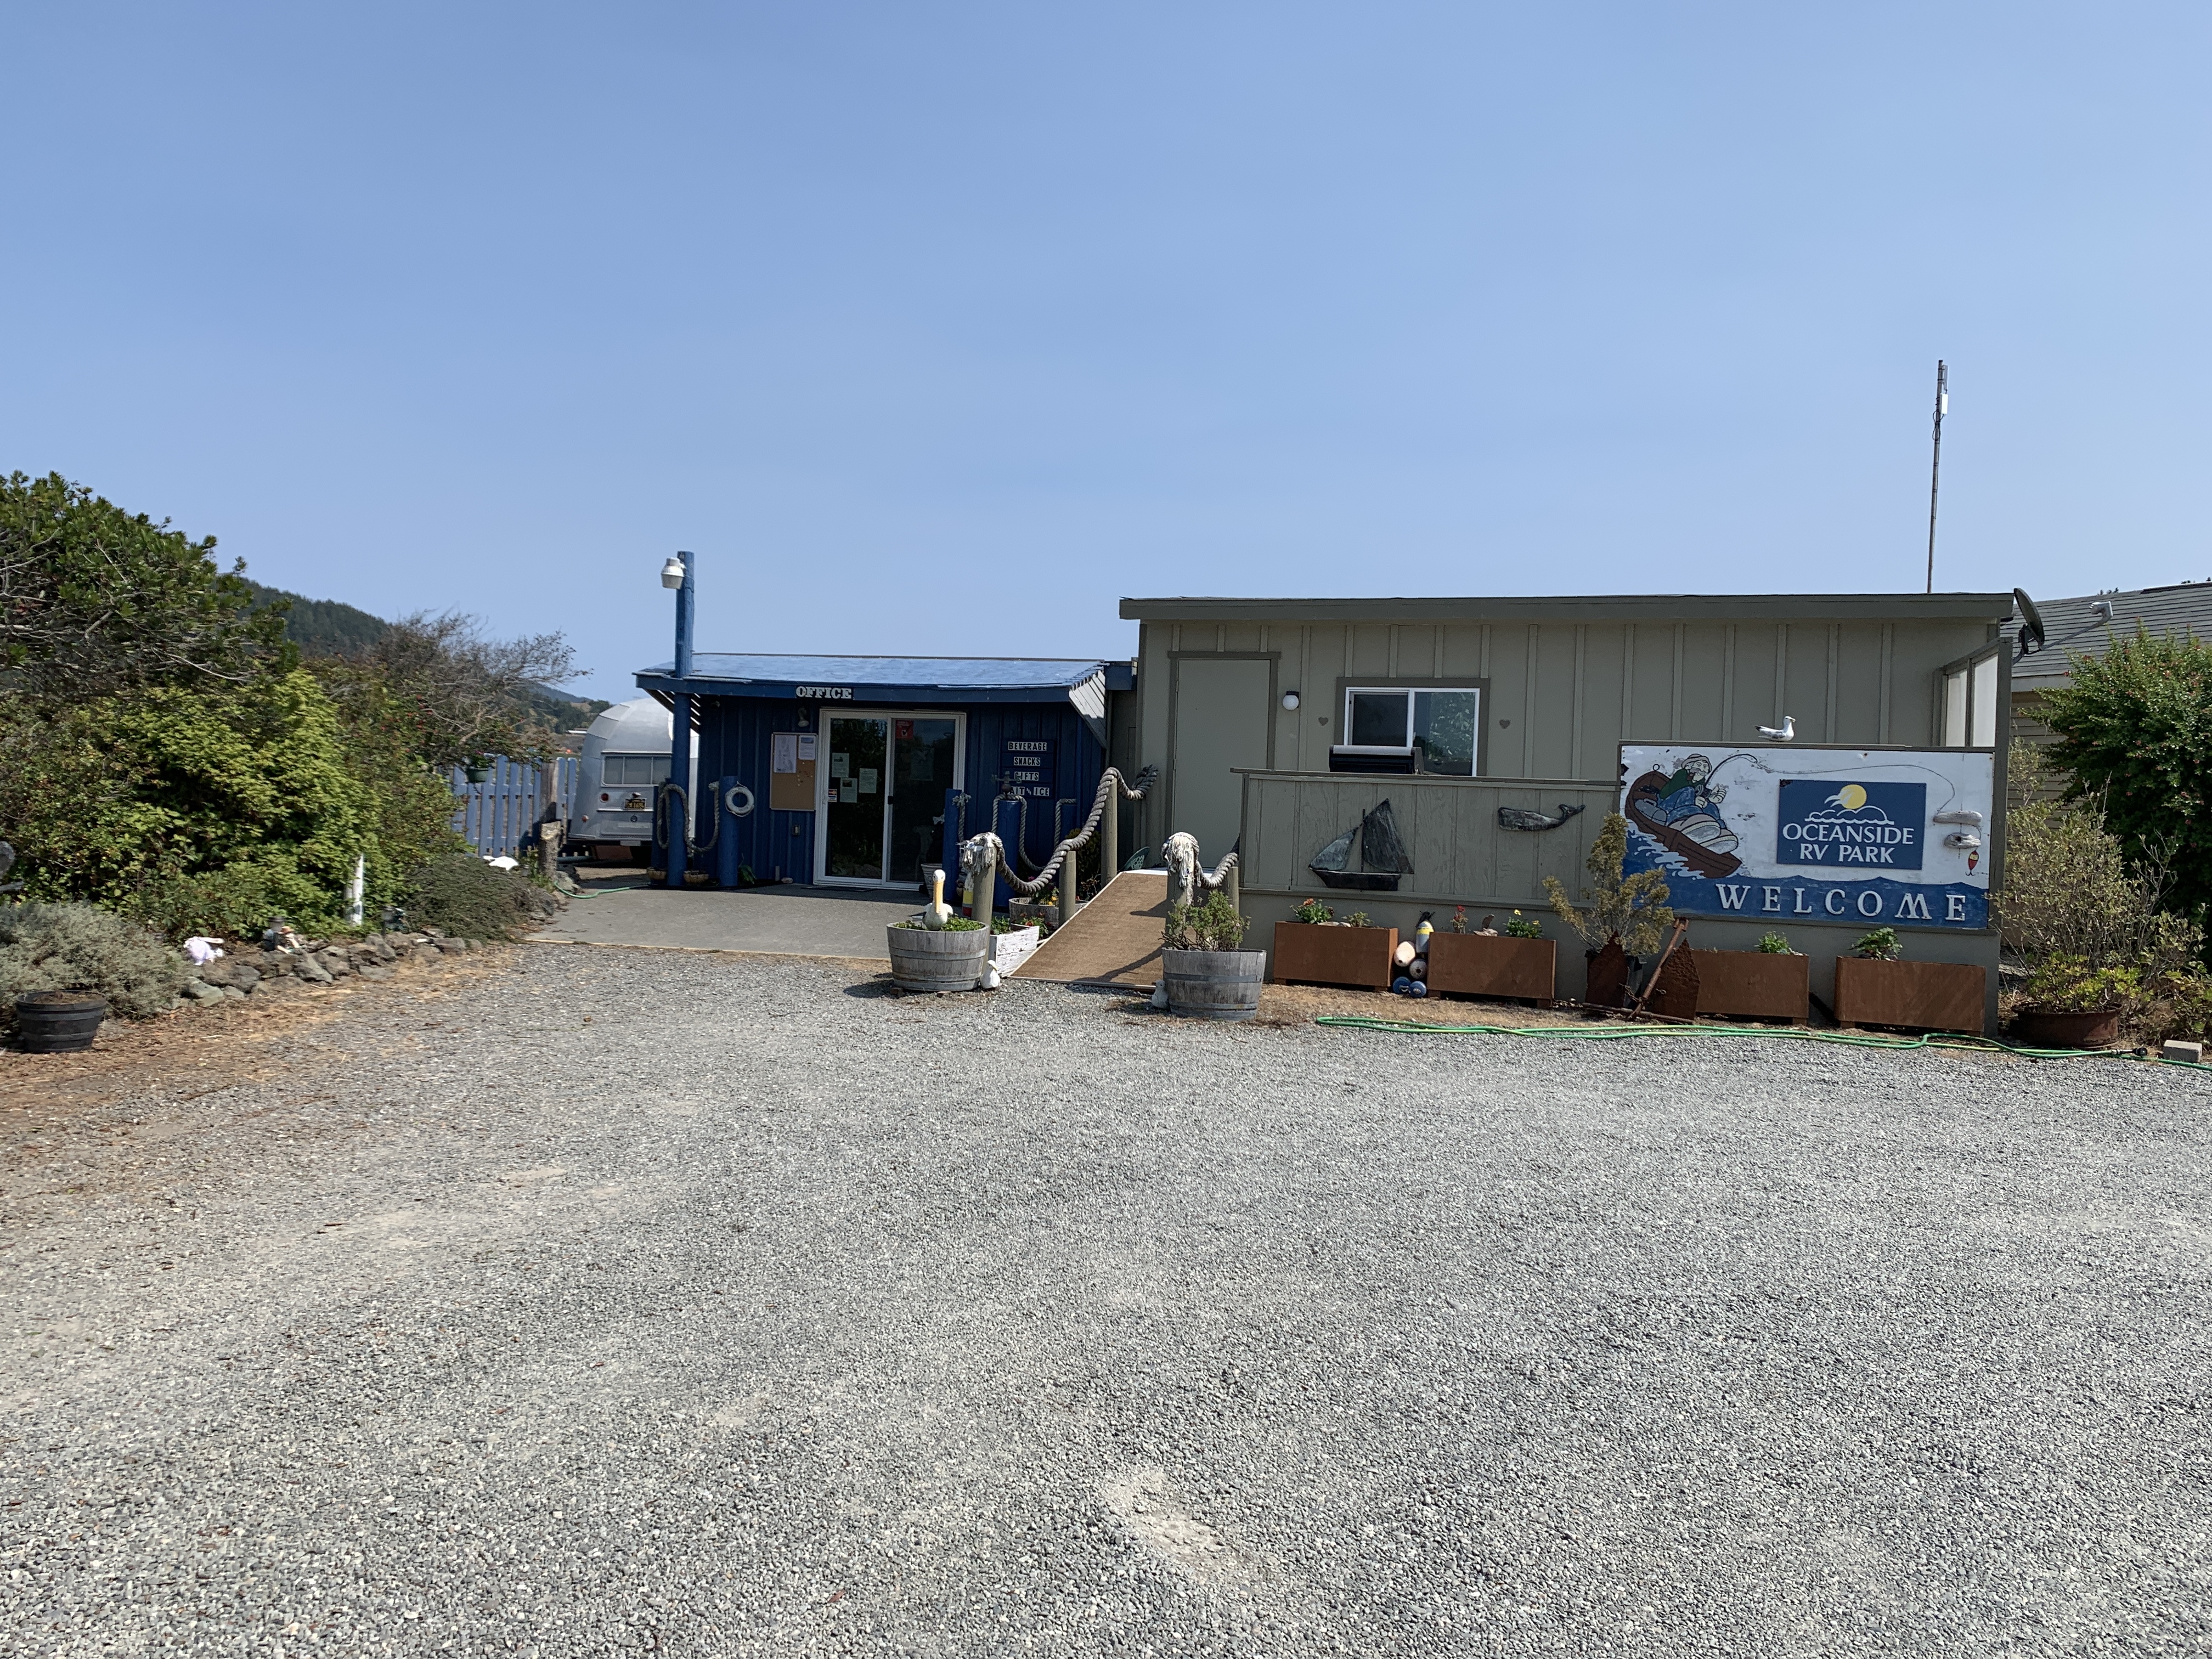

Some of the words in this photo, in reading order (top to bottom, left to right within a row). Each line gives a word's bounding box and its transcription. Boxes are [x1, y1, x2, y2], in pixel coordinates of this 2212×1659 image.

[795, 686, 852, 699] OFFICE
[1009, 742, 1046, 751] BEVERAGE
[1014, 757, 1040, 766] SNACKS
[1006, 787, 1024, 795] AIT
[1035, 787, 1048, 795] ICE
[1782, 823, 1915, 845] OCEANSIDE
[1800, 843, 1829, 860] RV
[1838, 844, 1895, 864] PARK
[1716, 884, 1966, 921] WELCOME
